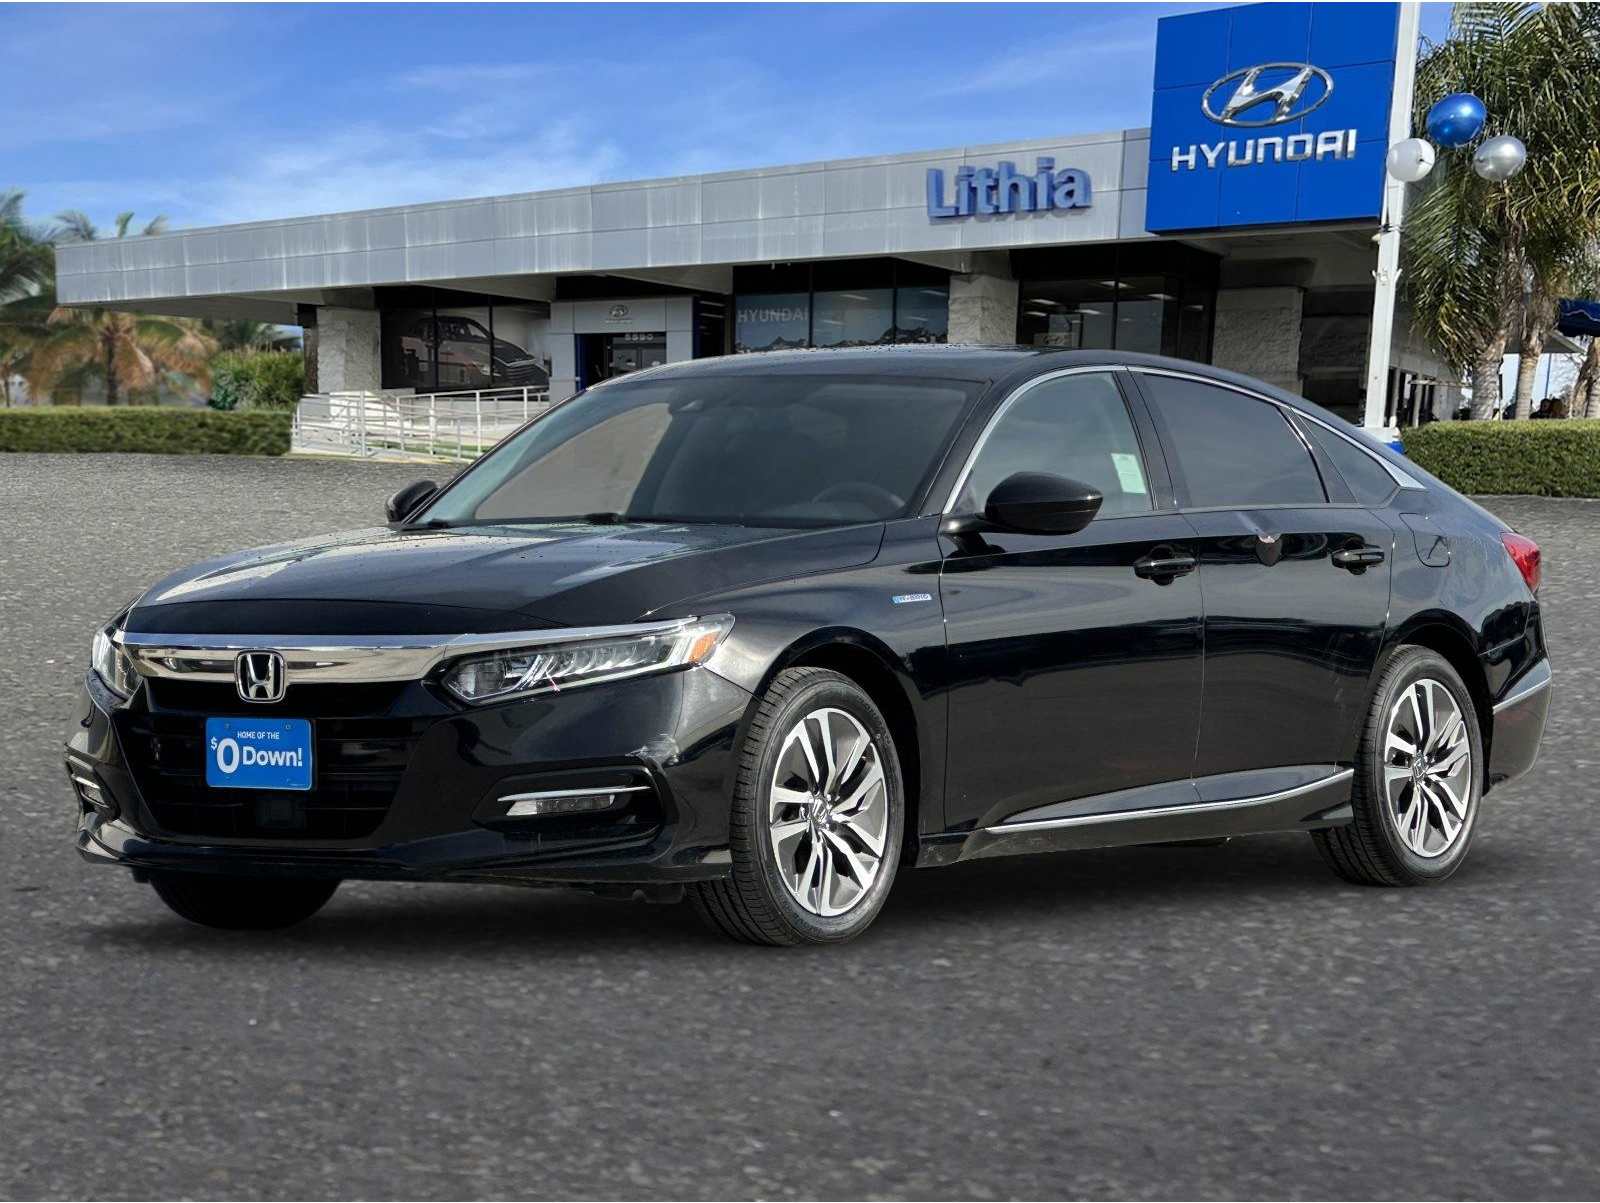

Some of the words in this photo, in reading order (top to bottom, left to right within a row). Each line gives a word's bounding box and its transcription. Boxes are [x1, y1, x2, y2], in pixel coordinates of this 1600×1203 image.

[1171, 129, 1357, 172] HYUNDAI
[927, 156, 1092, 217] Lithia
[737, 307, 809, 322] HYUNDAI
[236, 730, 256, 740] HOME
[256, 731, 266, 740] OF
[266, 731, 280, 740] THE
[242, 745, 303, 768] Down!
